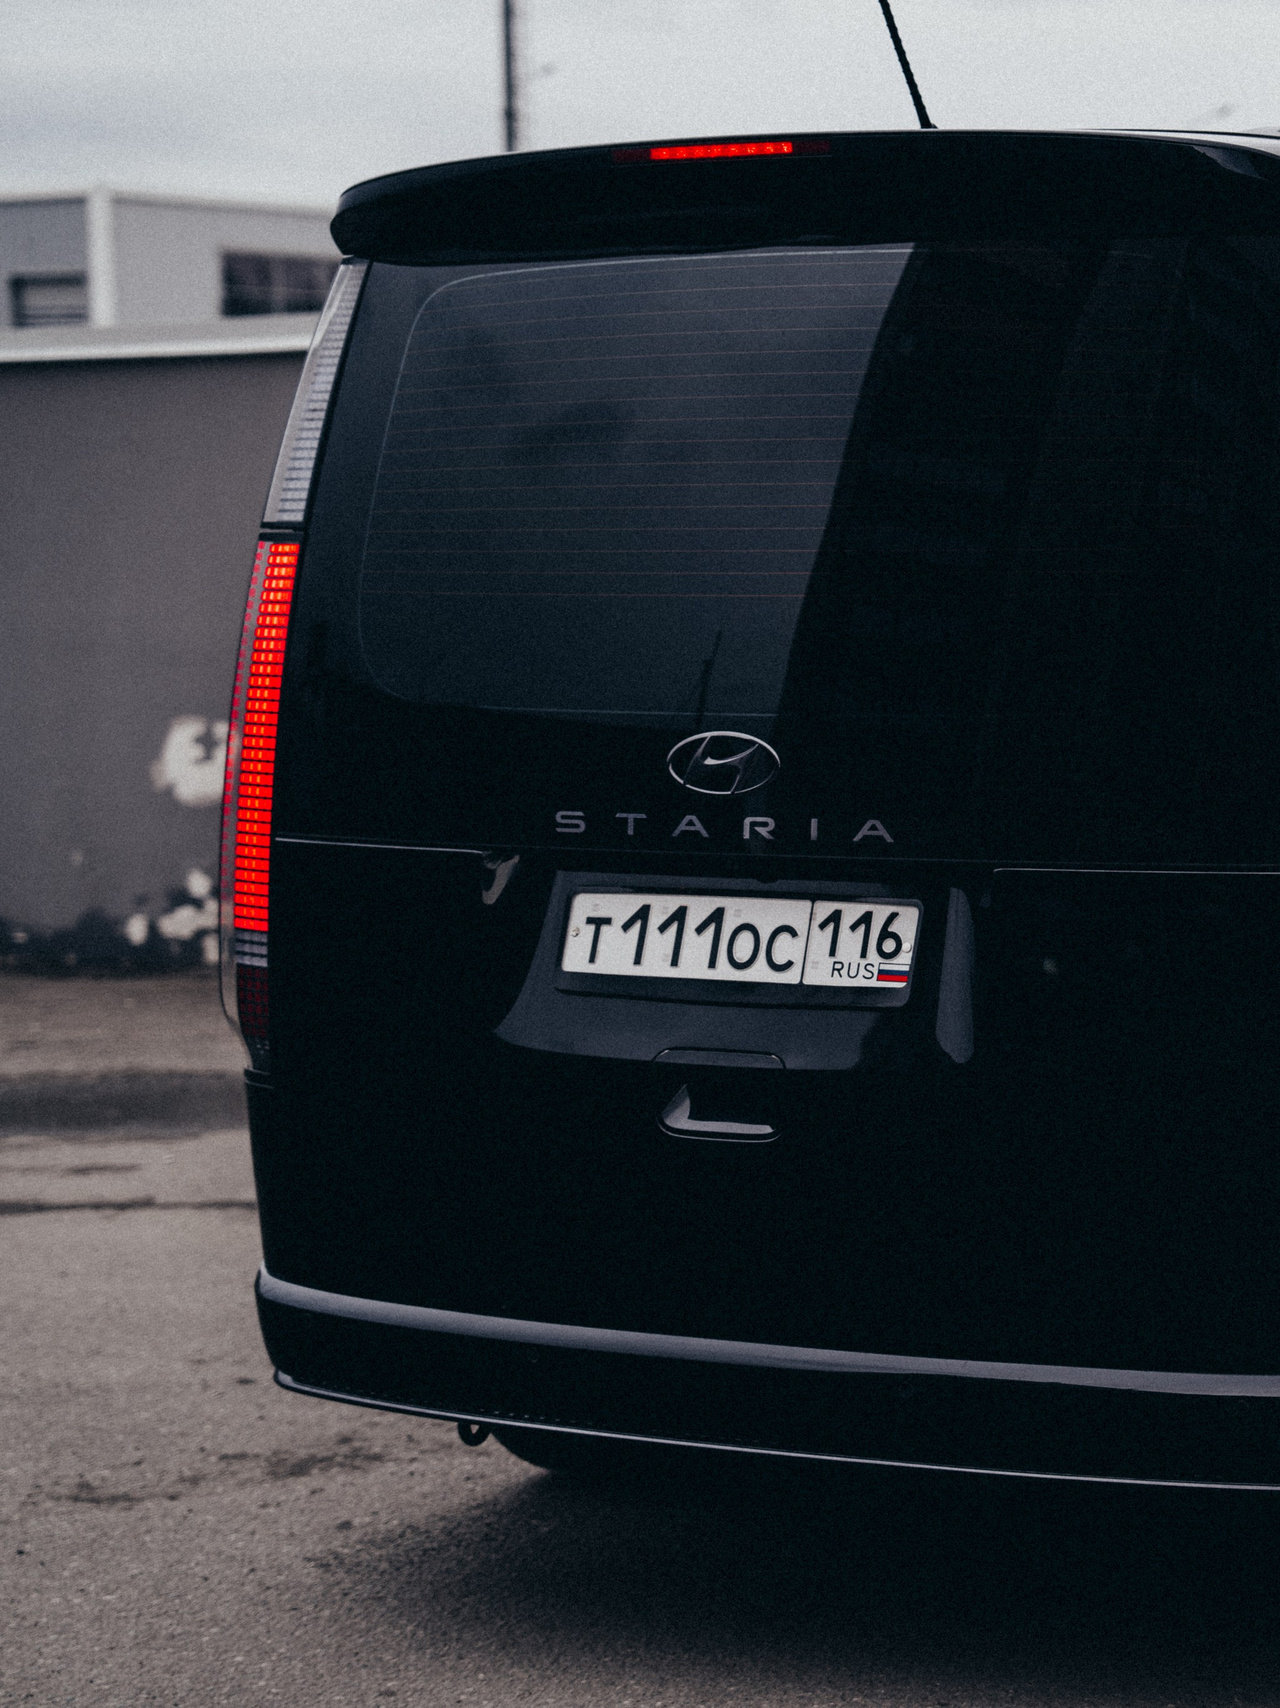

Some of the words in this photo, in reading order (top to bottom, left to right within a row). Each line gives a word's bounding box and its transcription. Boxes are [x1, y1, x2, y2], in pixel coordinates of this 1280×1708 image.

[555, 810, 895, 843] STARIA
[817, 908, 903, 960] 116
[830, 960, 875, 980] RUS
